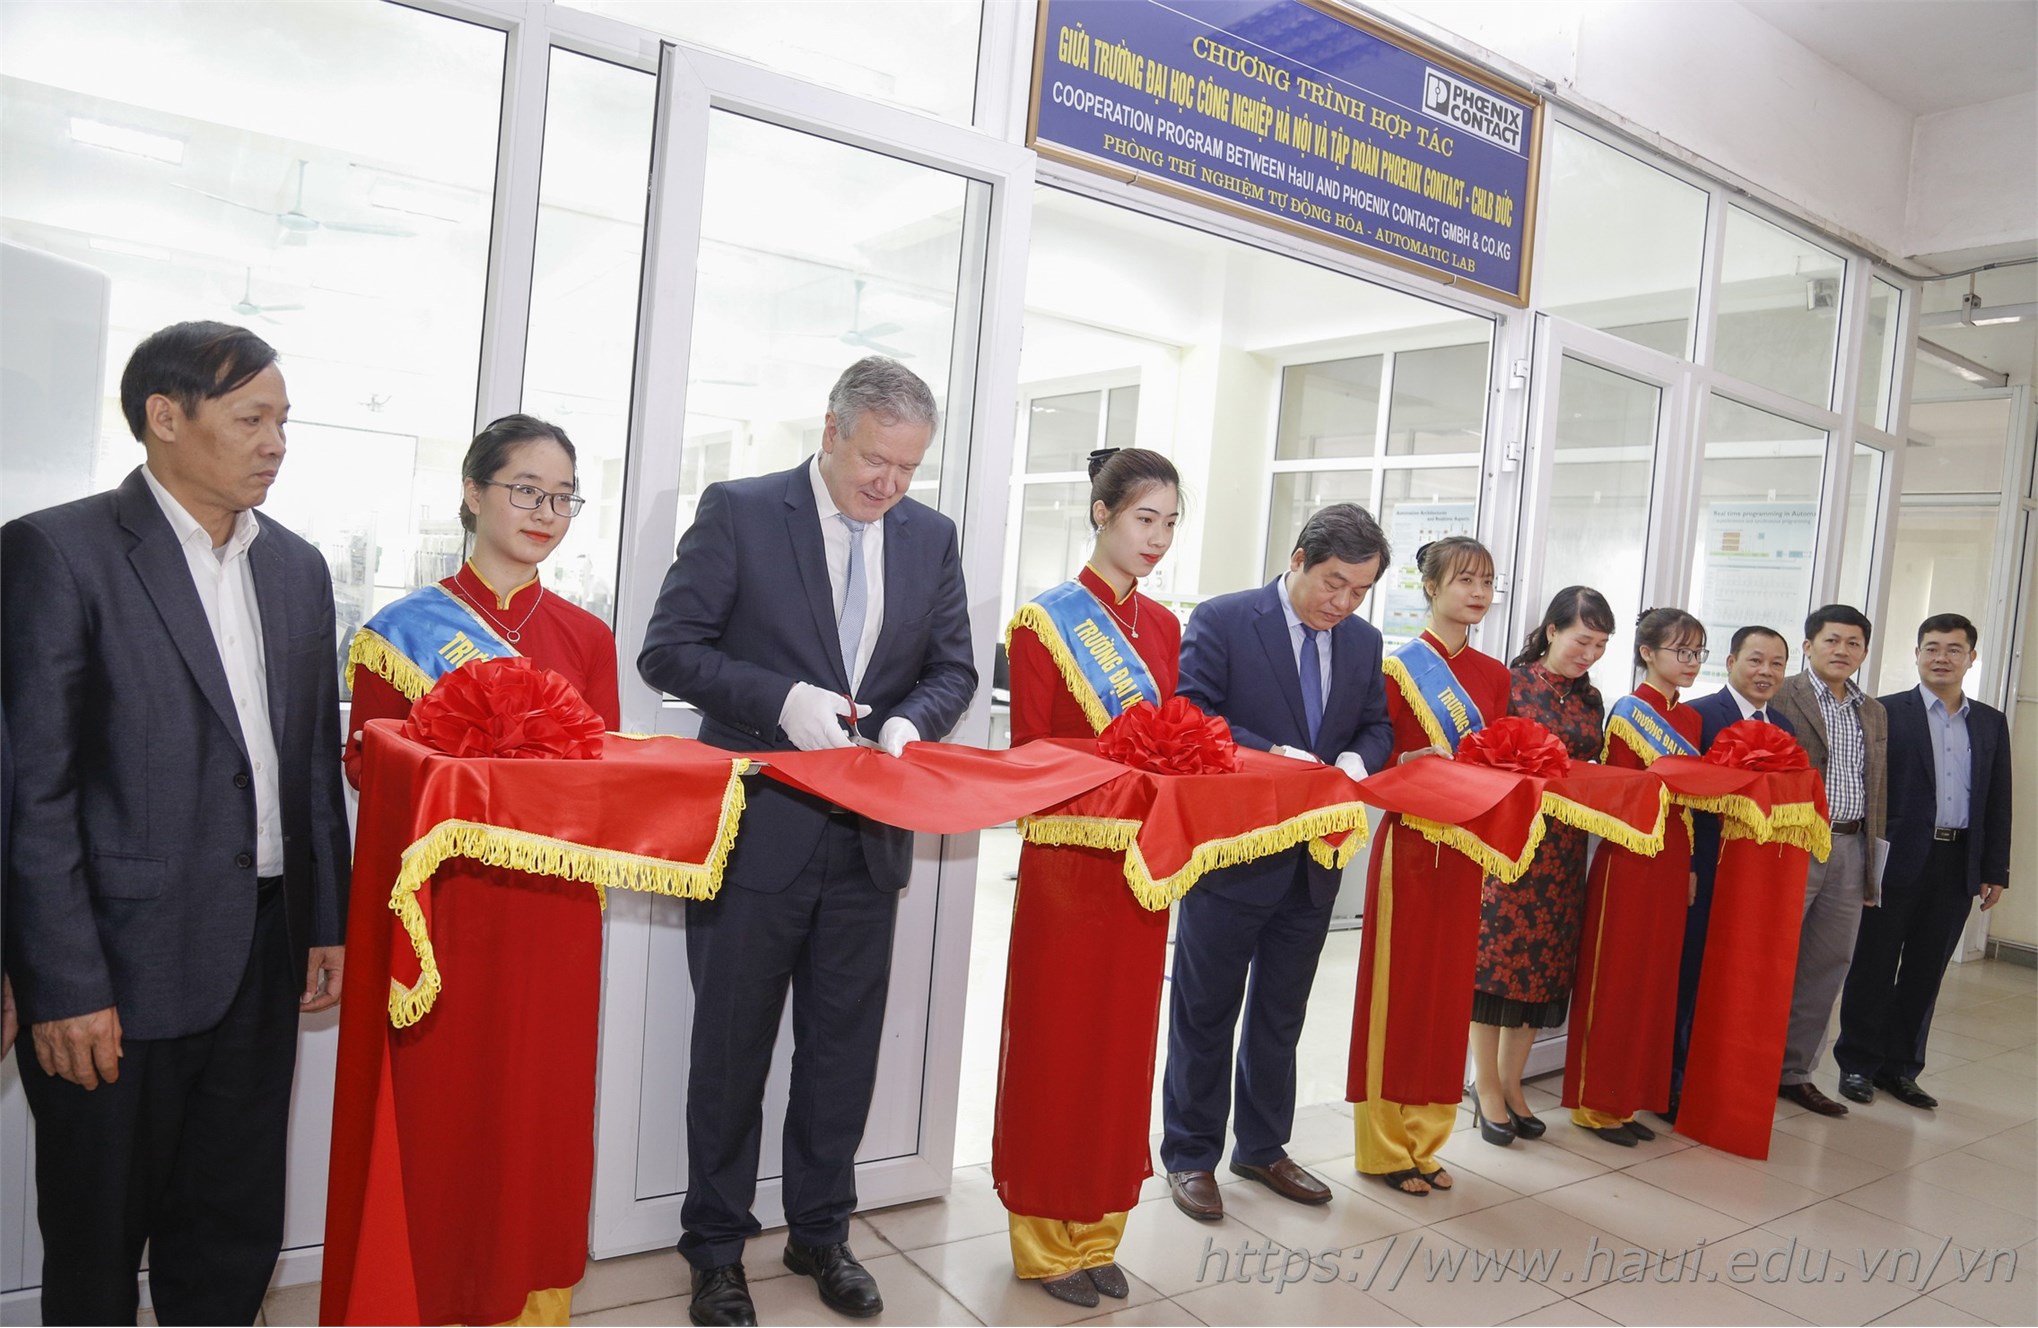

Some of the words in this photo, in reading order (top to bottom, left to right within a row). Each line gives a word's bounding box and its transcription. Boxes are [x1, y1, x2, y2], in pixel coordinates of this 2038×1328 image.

[1058, 22, 1090, 71] GIỮA
[1093, 39, 1144, 91] TRƯỜNG
[1146, 59, 1168, 104] ĐẠI
[1169, 69, 1195, 113] HỌC
[1197, 75, 1230, 123] CÔNG
[1231, 96, 1274, 143] NGHIỆP
[1274, 105, 1291, 145] HÀ
[1292, 113, 1313, 158] NỘI
[1314, 120, 1328, 159] VÀ
[1330, 126, 1350, 171] TẬP
[1351, 137, 1380, 178] ĐOÀN
[1380, 150, 1423, 195] PHOENIX
[1423, 167, 1465, 210] CONTACT
[1471, 185, 1494, 221] CHLB
[1495, 189, 1513, 228] ĐỨC
[1192, 36, 1291, 92] CHƯƠNG
[1296, 77, 1366, 122] TRÌNH
[1369, 107, 1412, 139] HỢP
[1416, 127, 1454, 158] TÁC
[1450, 103, 1520, 146] CONTACT
[1052, 81, 1154, 135] COOPERATION
[1156, 118, 1223, 160] PROGRAM
[1226, 142, 1286, 181] BETWEEN
[1288, 165, 1314, 191] HaUI
[1315, 175, 1340, 200] AND
[1342, 184, 1390, 219] PHOENIX
[1392, 202, 1440, 235] CONTACT
[1441, 221, 1471, 247] GMBH
[1472, 232, 1479, 250] &
[1481, 235, 1511, 260] CO.KG
[1103, 134, 1164, 167] PHÒNG
[1168, 155, 1197, 178] THÍ
[1201, 166, 1264, 201] NGHIỆM
[1268, 189, 1288, 211] TỰ
[1290, 197, 1332, 224] ĐỘNG
[1334, 211, 1364, 235] HÓA
[1374, 227, 1449, 264] AUTOMATIC
[1451, 253, 1476, 272] LAB
[1073, 618, 1123, 673] TRƯỜNG
[1108, 667, 1138, 698] ĐẠI
[1437, 686, 1470, 733] TRƯỜNG
